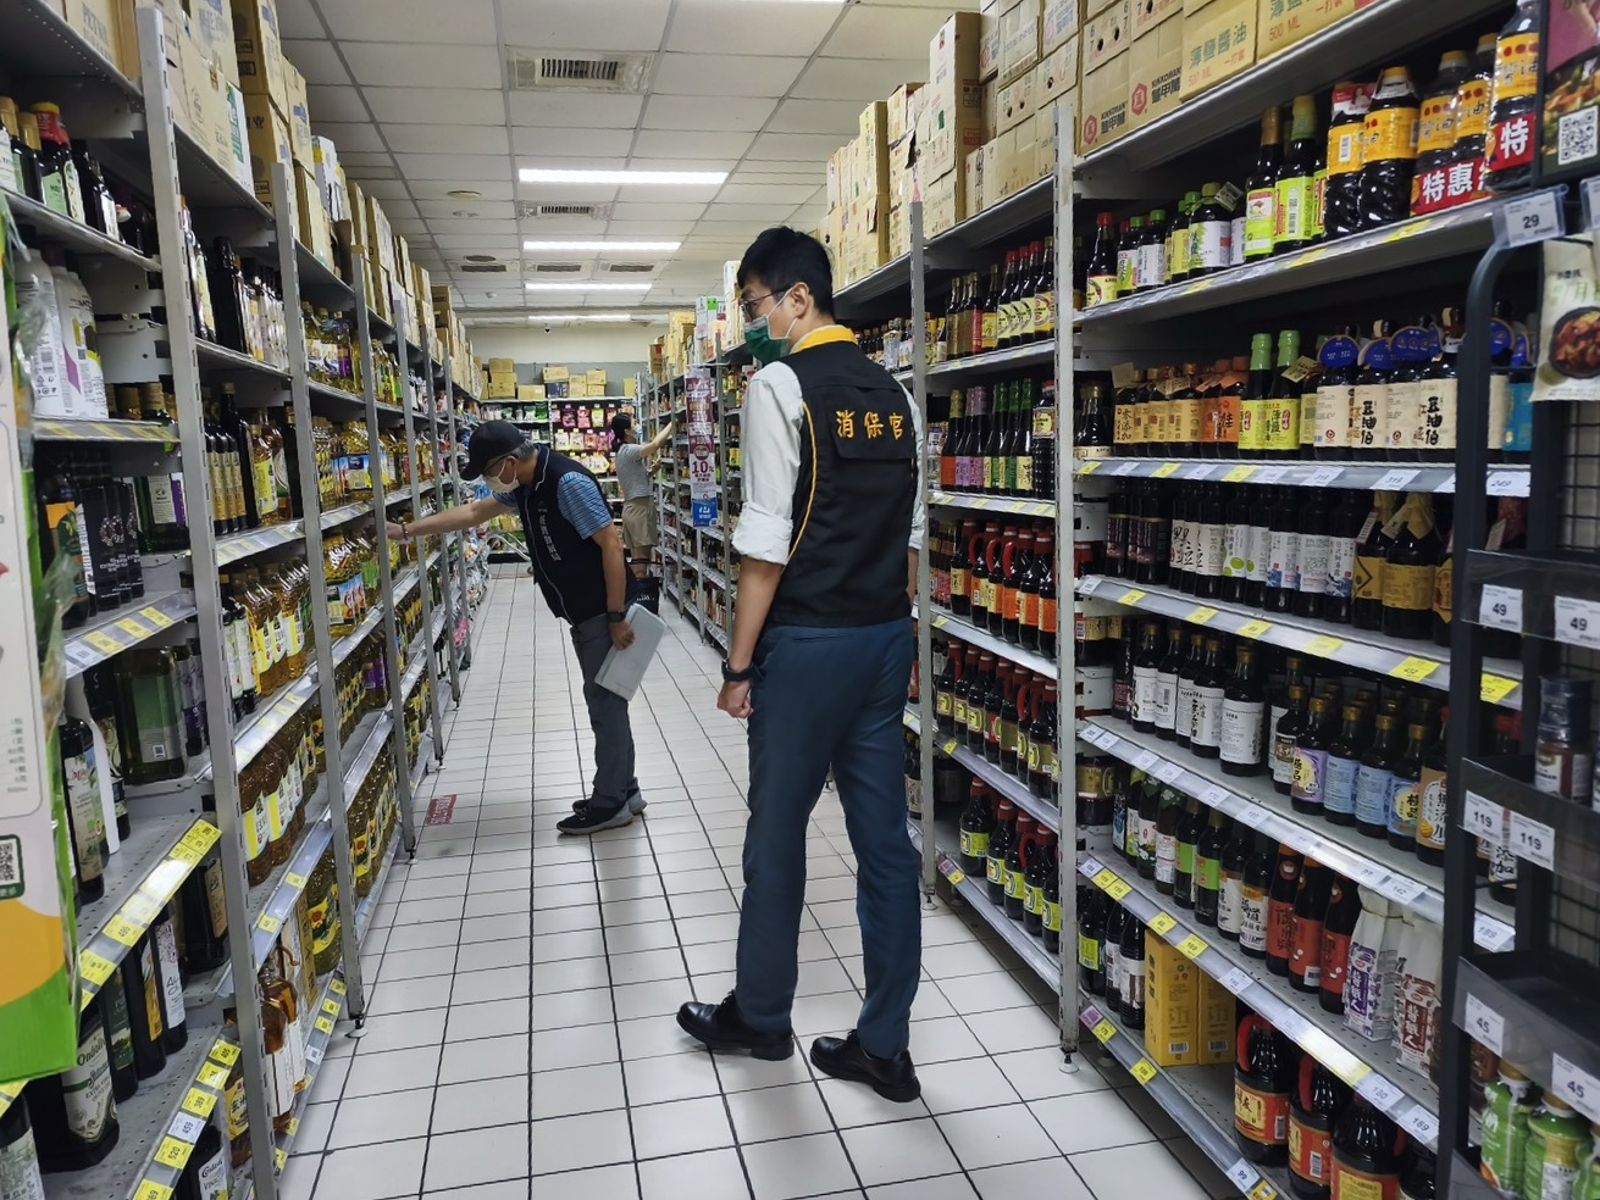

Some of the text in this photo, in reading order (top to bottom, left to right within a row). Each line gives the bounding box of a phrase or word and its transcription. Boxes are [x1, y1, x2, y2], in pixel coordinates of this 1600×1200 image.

[1269, 23, 1284, 41] 500
[1501, 118, 1529, 160] 特
[1522, 214, 1540, 229] 29
[836, 410, 904, 440] 消保官
[1360, 400, 1377, 445] 豆油伯
[1425, 395, 1443, 446] 豆油伯
[1492, 603, 1507, 616] 49
[1569, 617, 1588, 631] 49
[1473, 810, 1493, 828] 119
[1520, 832, 1542, 850] 119
[1476, 1016, 1491, 1034] 45
[1566, 1081, 1585, 1099] 45
